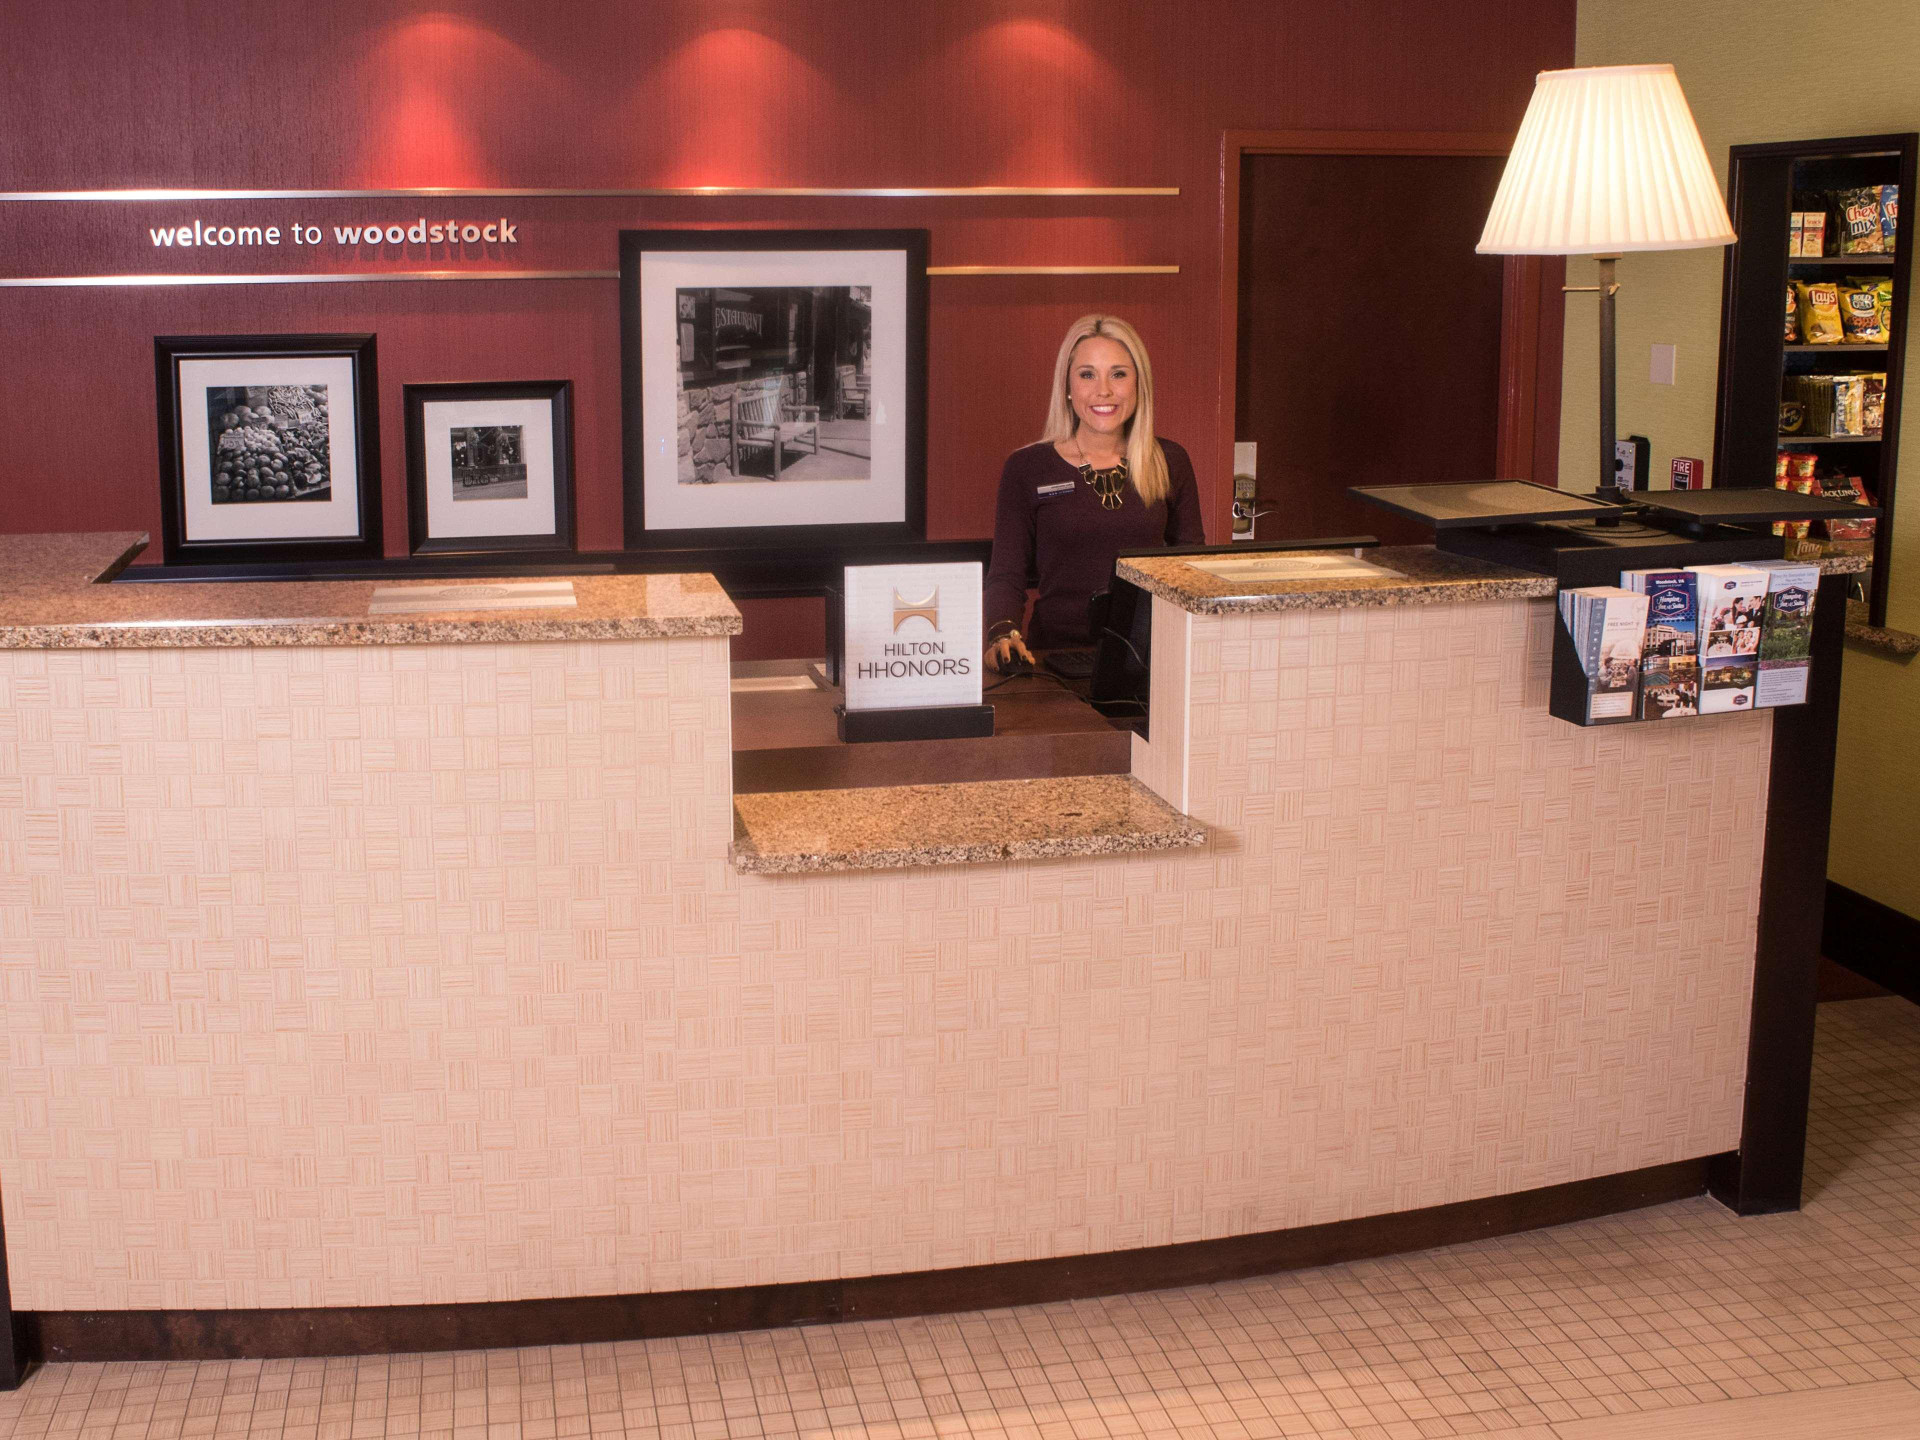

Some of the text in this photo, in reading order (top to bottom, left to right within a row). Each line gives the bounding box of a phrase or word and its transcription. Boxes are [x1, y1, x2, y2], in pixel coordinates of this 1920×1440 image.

[1846, 202, 1877, 222] Chex
[1885, 200, 1899, 219] Ch
[149, 218, 518, 247] welcome to woodstock
[1811, 290, 1836, 306] Lay's
[714, 307, 763, 336] ESTAURANT
[1673, 460, 1691, 474] FIRE
[884, 641, 944, 657] HILTON
[858, 658, 970, 679] HHONORS
